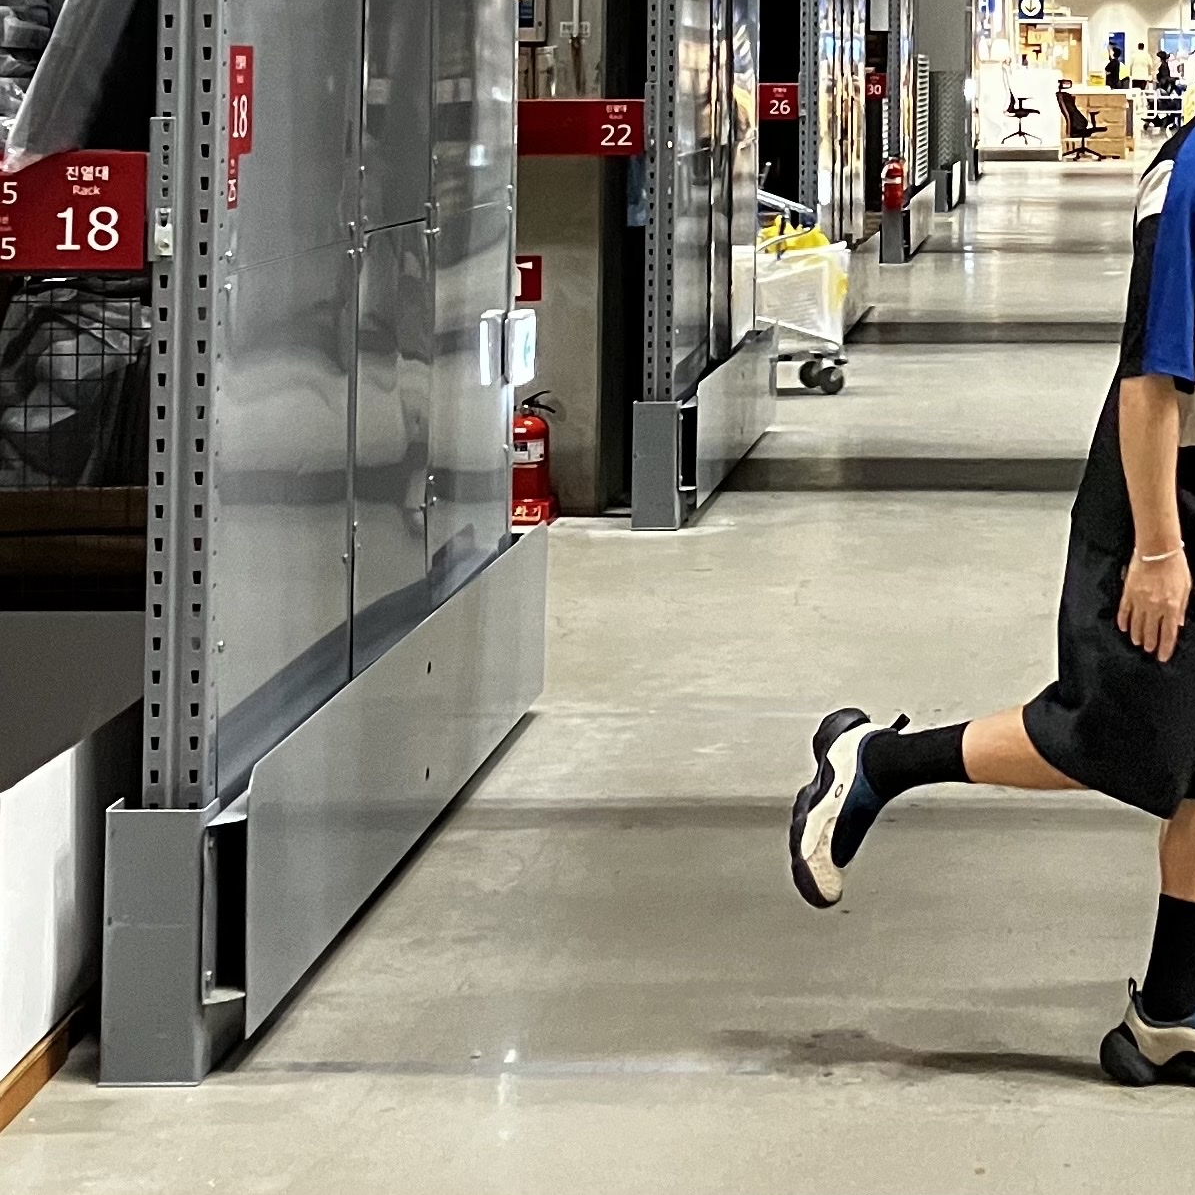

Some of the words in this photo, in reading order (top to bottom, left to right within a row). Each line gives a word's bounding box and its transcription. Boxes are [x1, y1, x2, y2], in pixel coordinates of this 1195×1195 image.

[232, 94, 248, 138] 18
[769, 99, 791, 115] 26
[600, 124, 633, 146] 22
[66, 165, 109, 181] 진열대
[72, 185, 101, 196] Rack
[56, 206, 119, 252] 18
